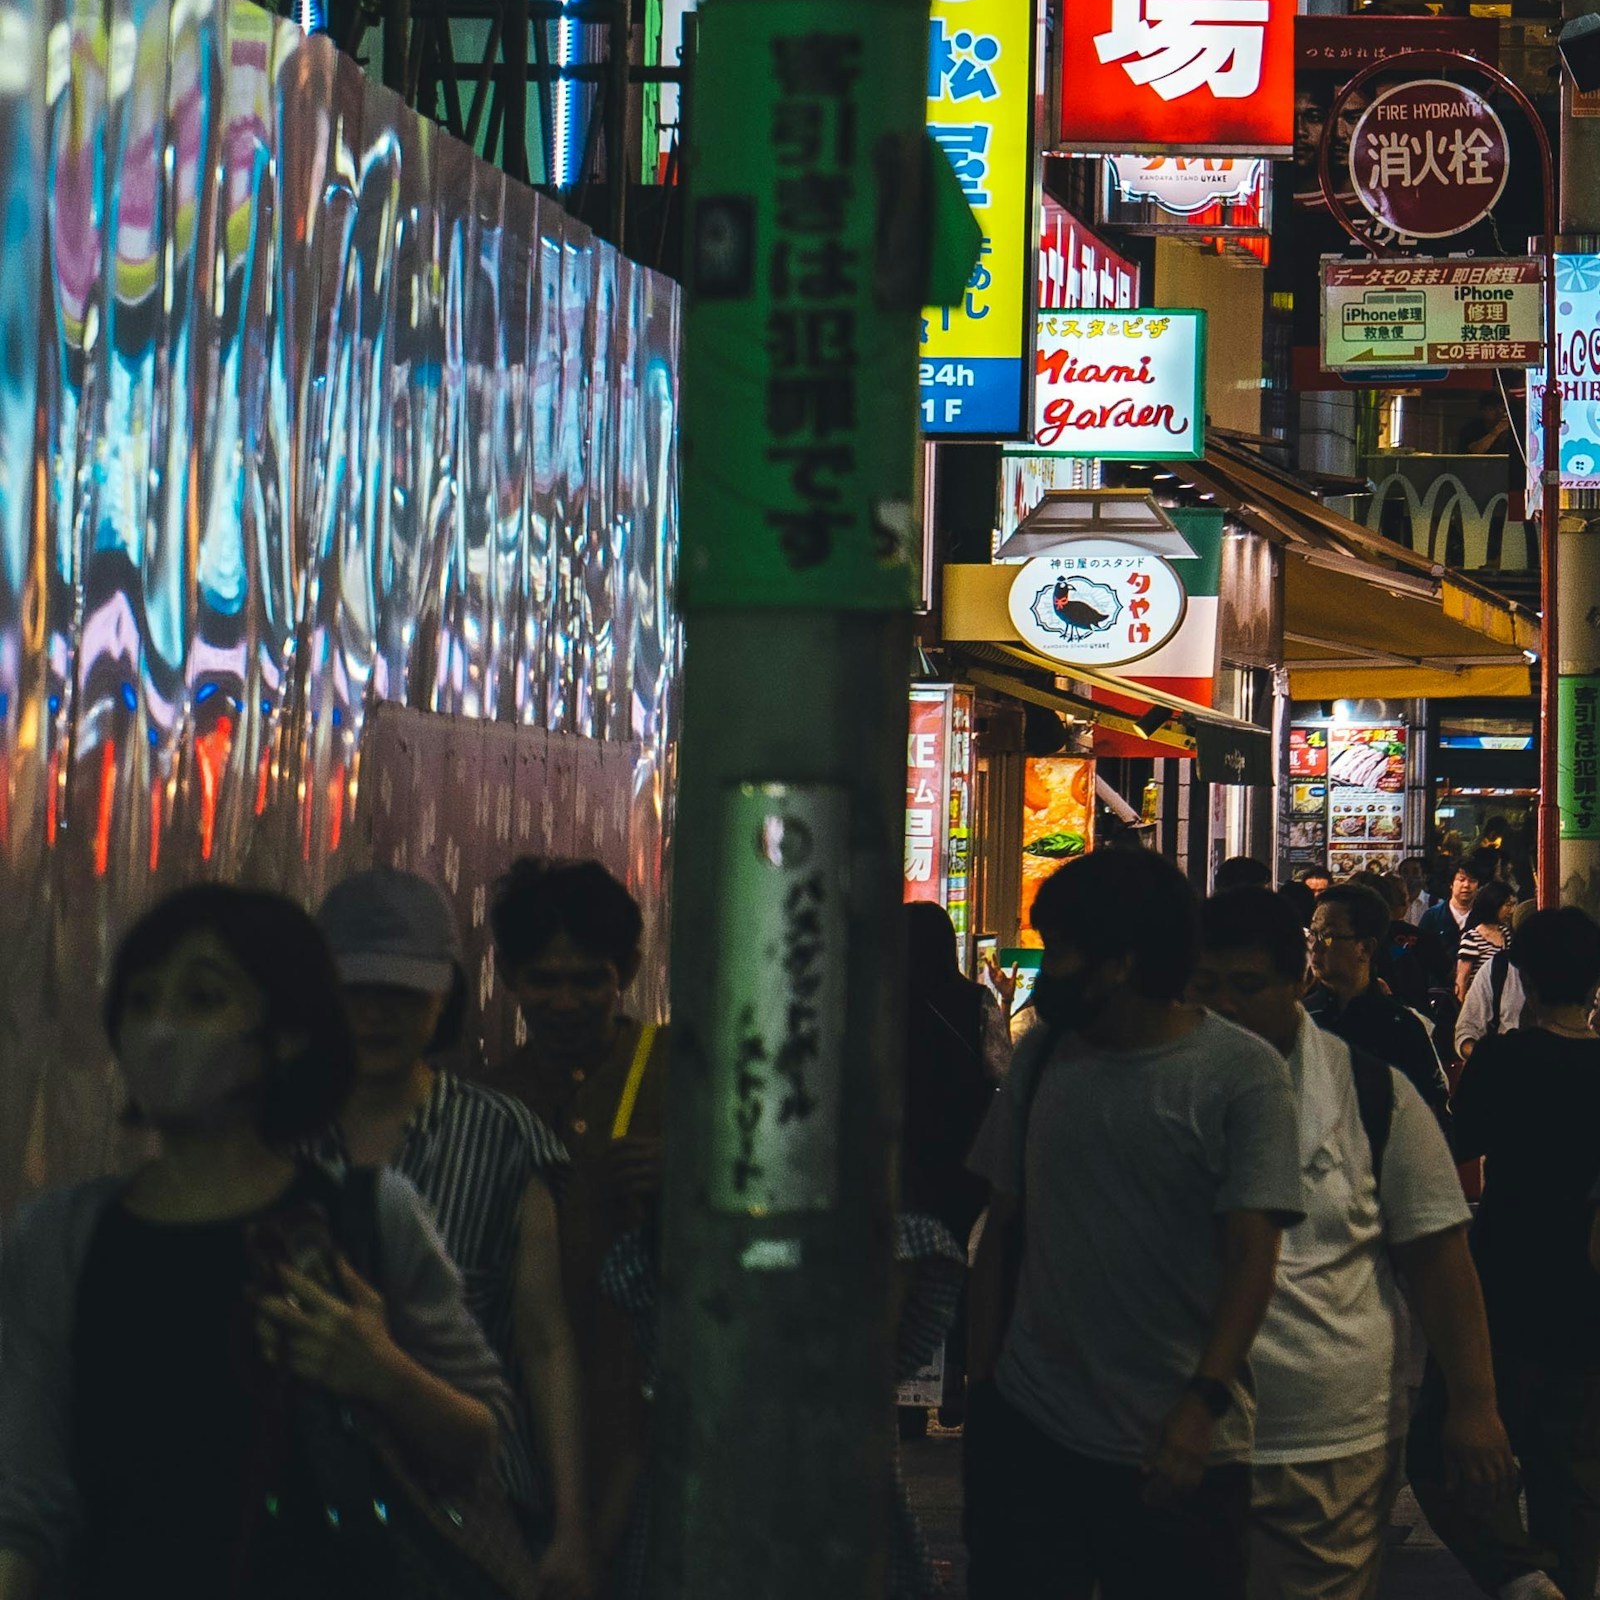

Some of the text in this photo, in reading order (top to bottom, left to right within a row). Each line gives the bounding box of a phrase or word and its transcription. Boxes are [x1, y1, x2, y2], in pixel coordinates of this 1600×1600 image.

[1377, 104, 1408, 121] FIRE
[1367, 129, 1494, 189] 消火栓
[1454, 286, 1514, 301] iPhone
[1346, 307, 1423, 322] iPhone修理
[1467, 304, 1505, 322] 修理
[1461, 324, 1511, 342] 救急便
[1436, 344, 1526, 360] この手前を左
[1036, 349, 1155, 385] Miami
